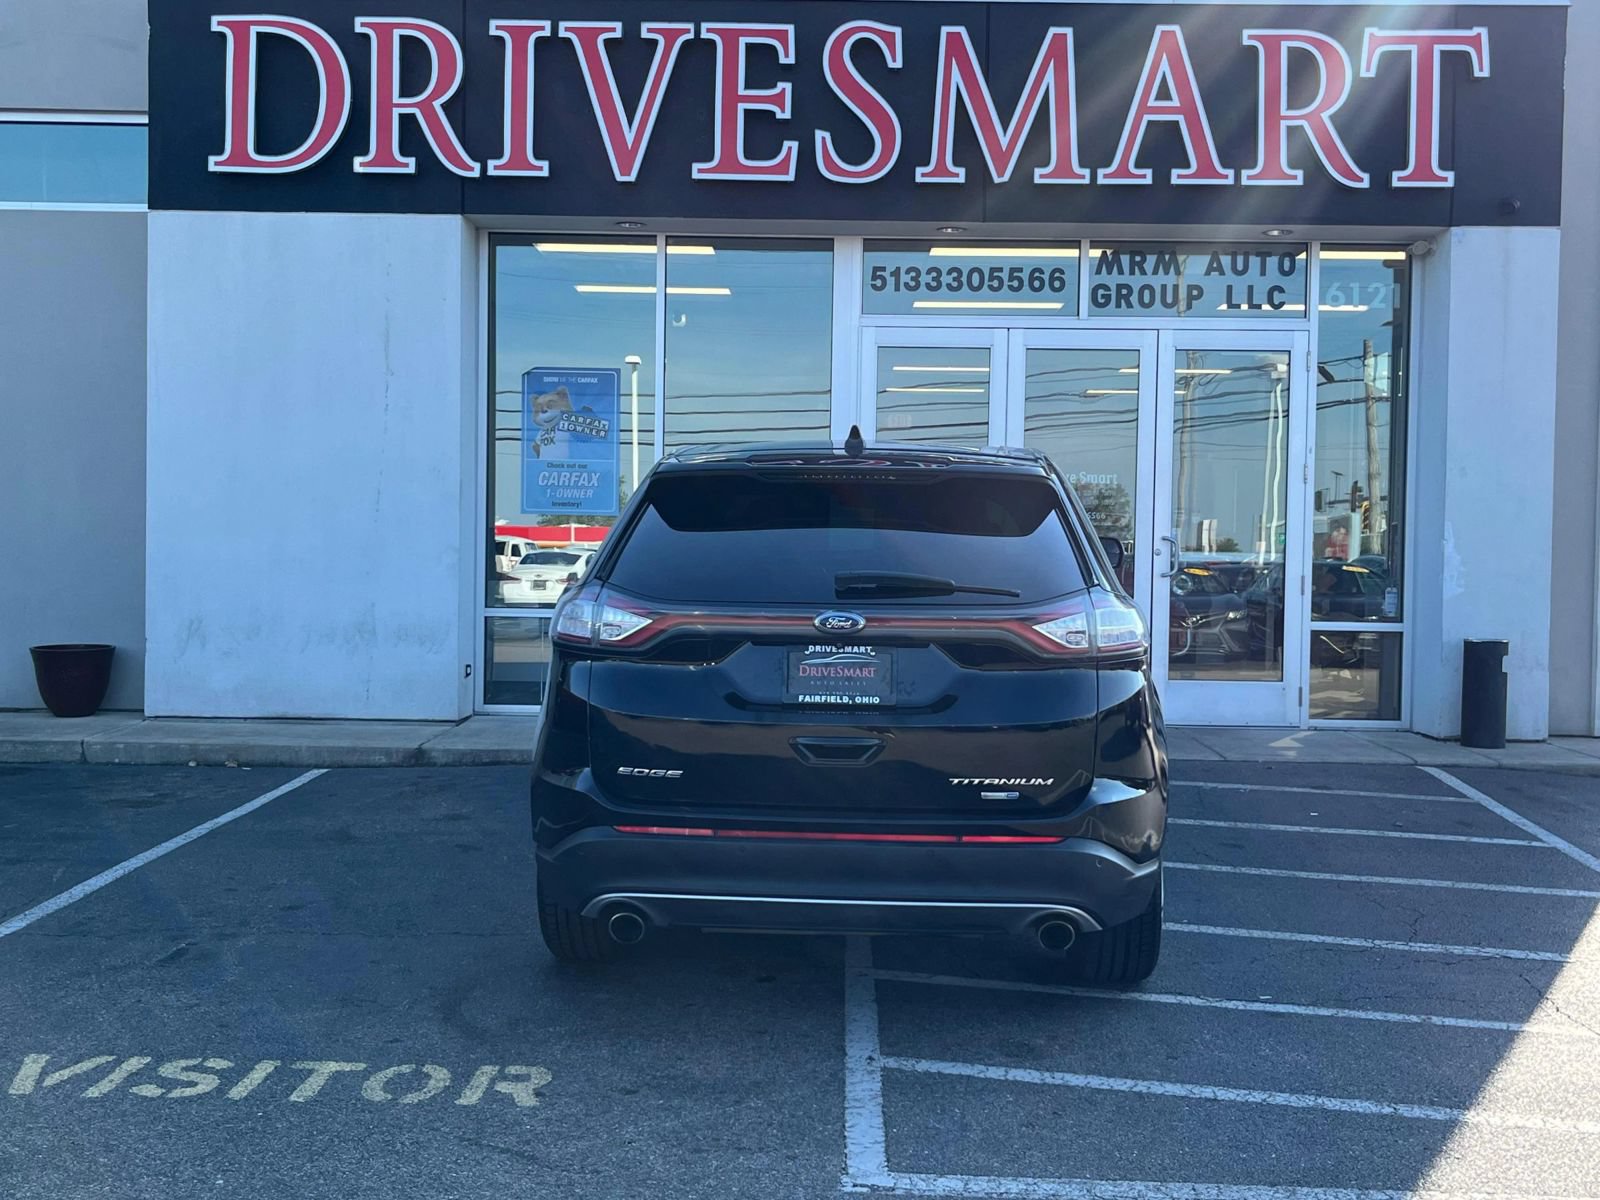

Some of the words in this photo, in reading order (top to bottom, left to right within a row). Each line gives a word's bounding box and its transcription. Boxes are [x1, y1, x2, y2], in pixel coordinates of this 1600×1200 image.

[208, 15, 1490, 188] DRIVESMART
[1094, 249, 1182, 276] MRM
[1203, 250, 1297, 277] AUTO
[870, 265, 1066, 293] 5133305566
[1090, 283, 1204, 310] GROUP
[1226, 284, 1287, 310] LLC
[562, 413, 609, 431] CARFAX
[568, 424, 607, 438] OWNER
[538, 471, 600, 487] CARFAX
[1079, 471, 1118, 485] Smart
[825, 616, 853, 629] Ford
[798, 694, 852, 704] FAIRFIELD,
[855, 695, 880, 704] OHIO
[617, 766, 684, 778] EDGE
[949, 778, 1054, 786] TITANIUM
[8, 1053, 553, 1106] VISITOR
